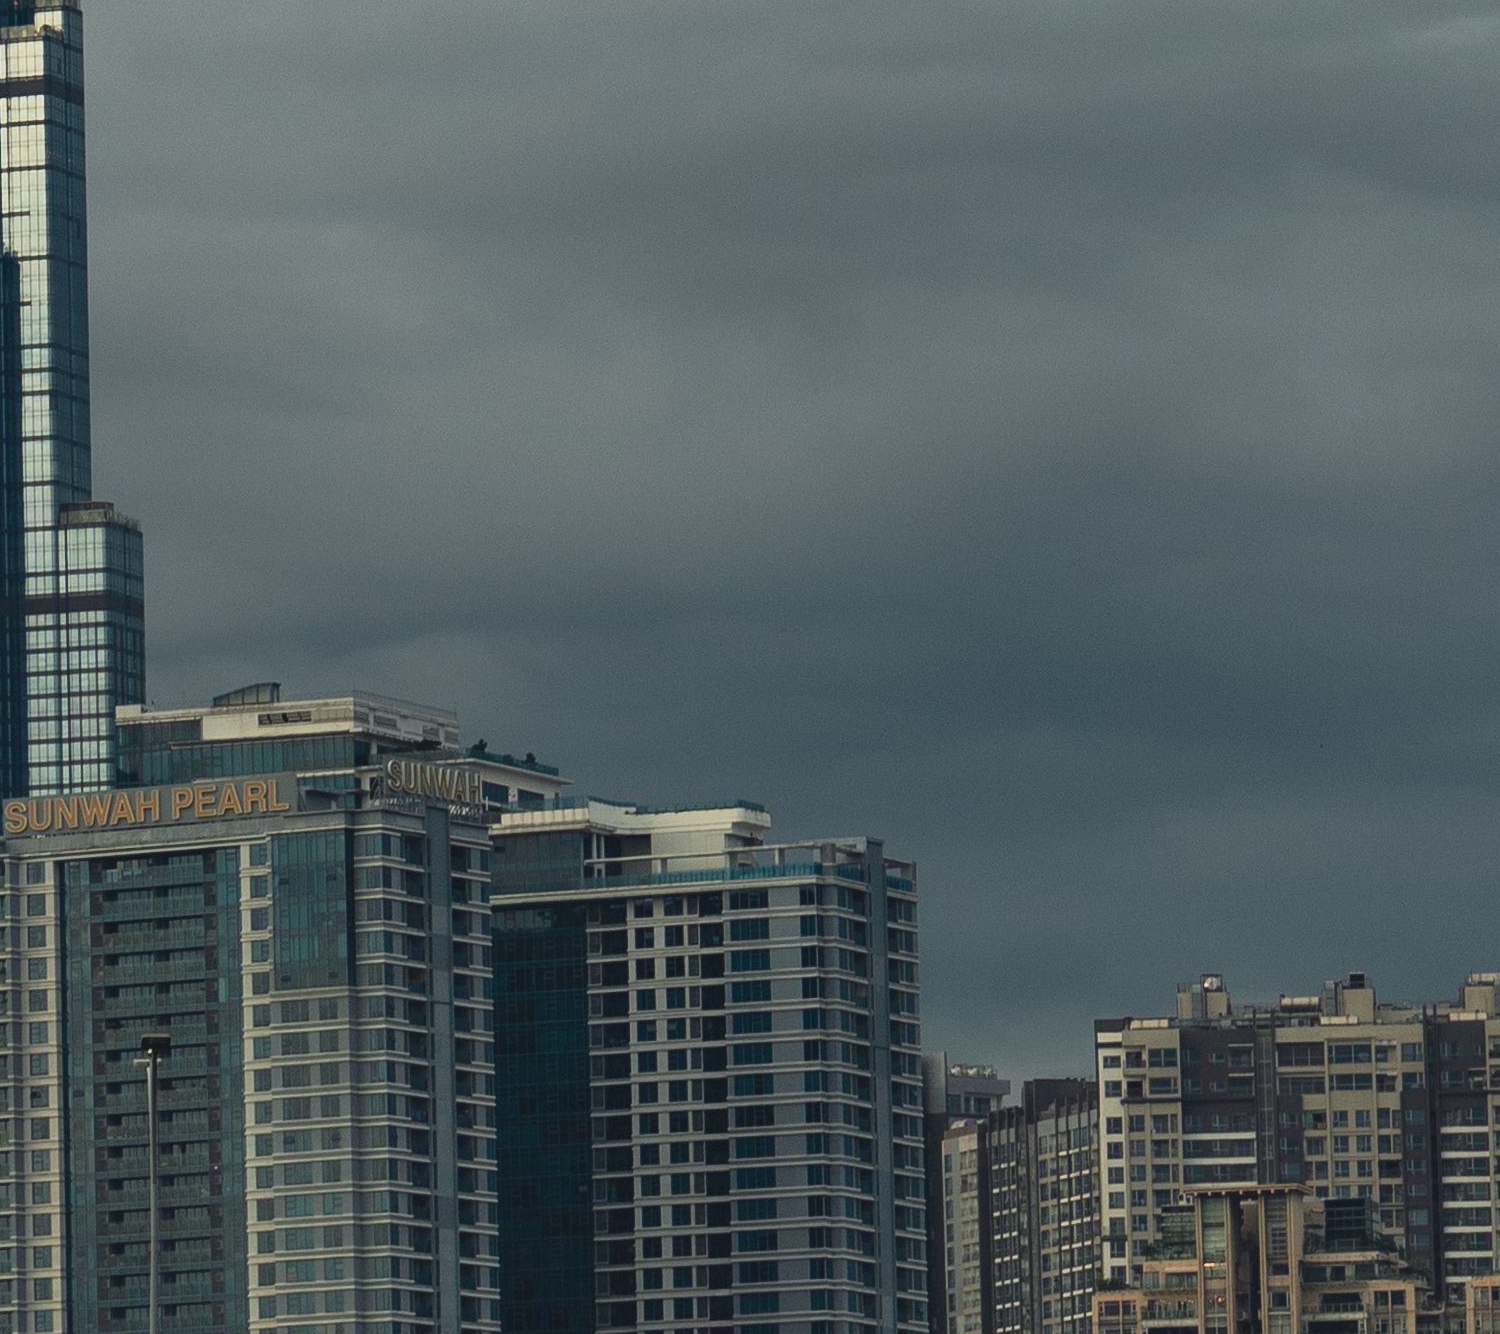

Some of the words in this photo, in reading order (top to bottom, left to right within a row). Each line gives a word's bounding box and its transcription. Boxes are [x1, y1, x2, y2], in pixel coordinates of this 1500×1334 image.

[4, 789, 160, 833] SUNWAH
[171, 779, 289, 820] PEARL
[387, 759, 481, 804] SUNWAH
